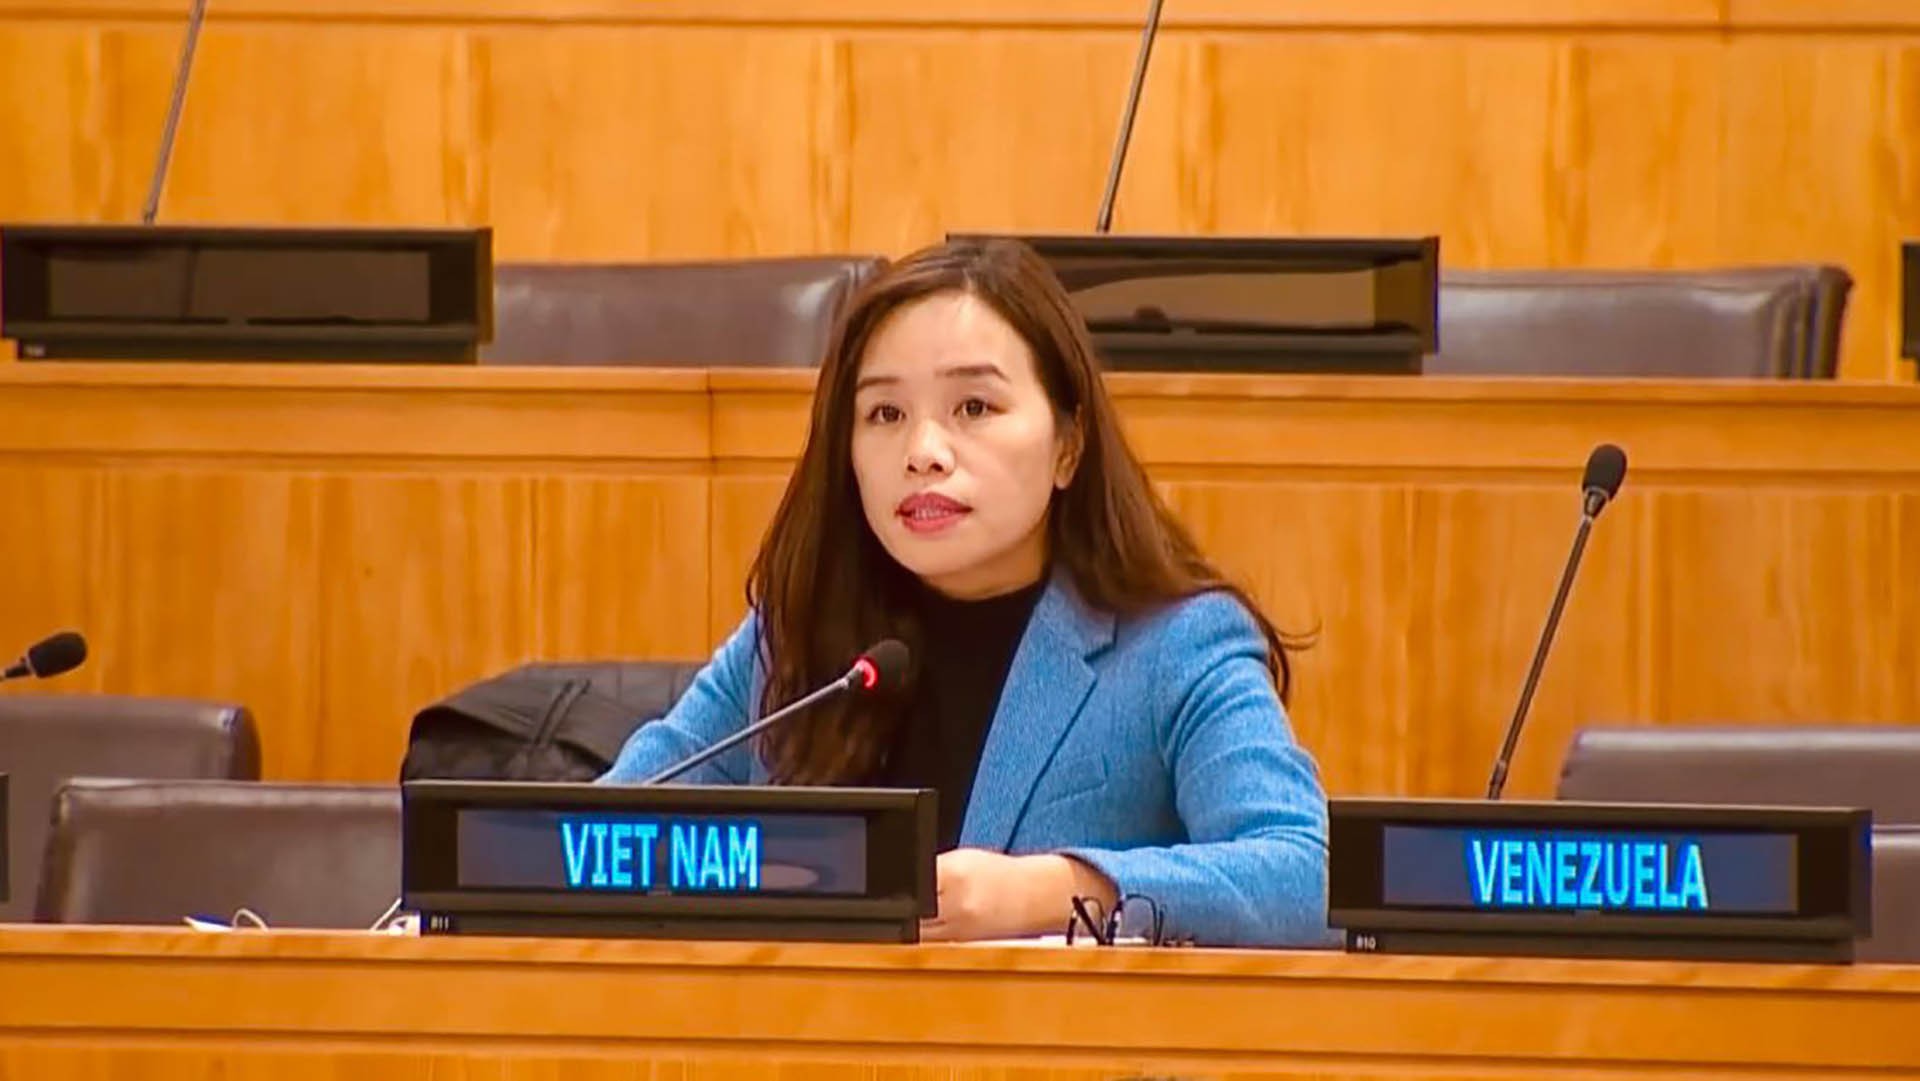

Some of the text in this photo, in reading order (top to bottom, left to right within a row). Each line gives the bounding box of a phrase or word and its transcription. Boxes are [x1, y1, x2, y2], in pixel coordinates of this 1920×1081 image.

[562, 823, 758, 888] VIET NAM
[1471, 840, 1709, 908] VENEZUELA
